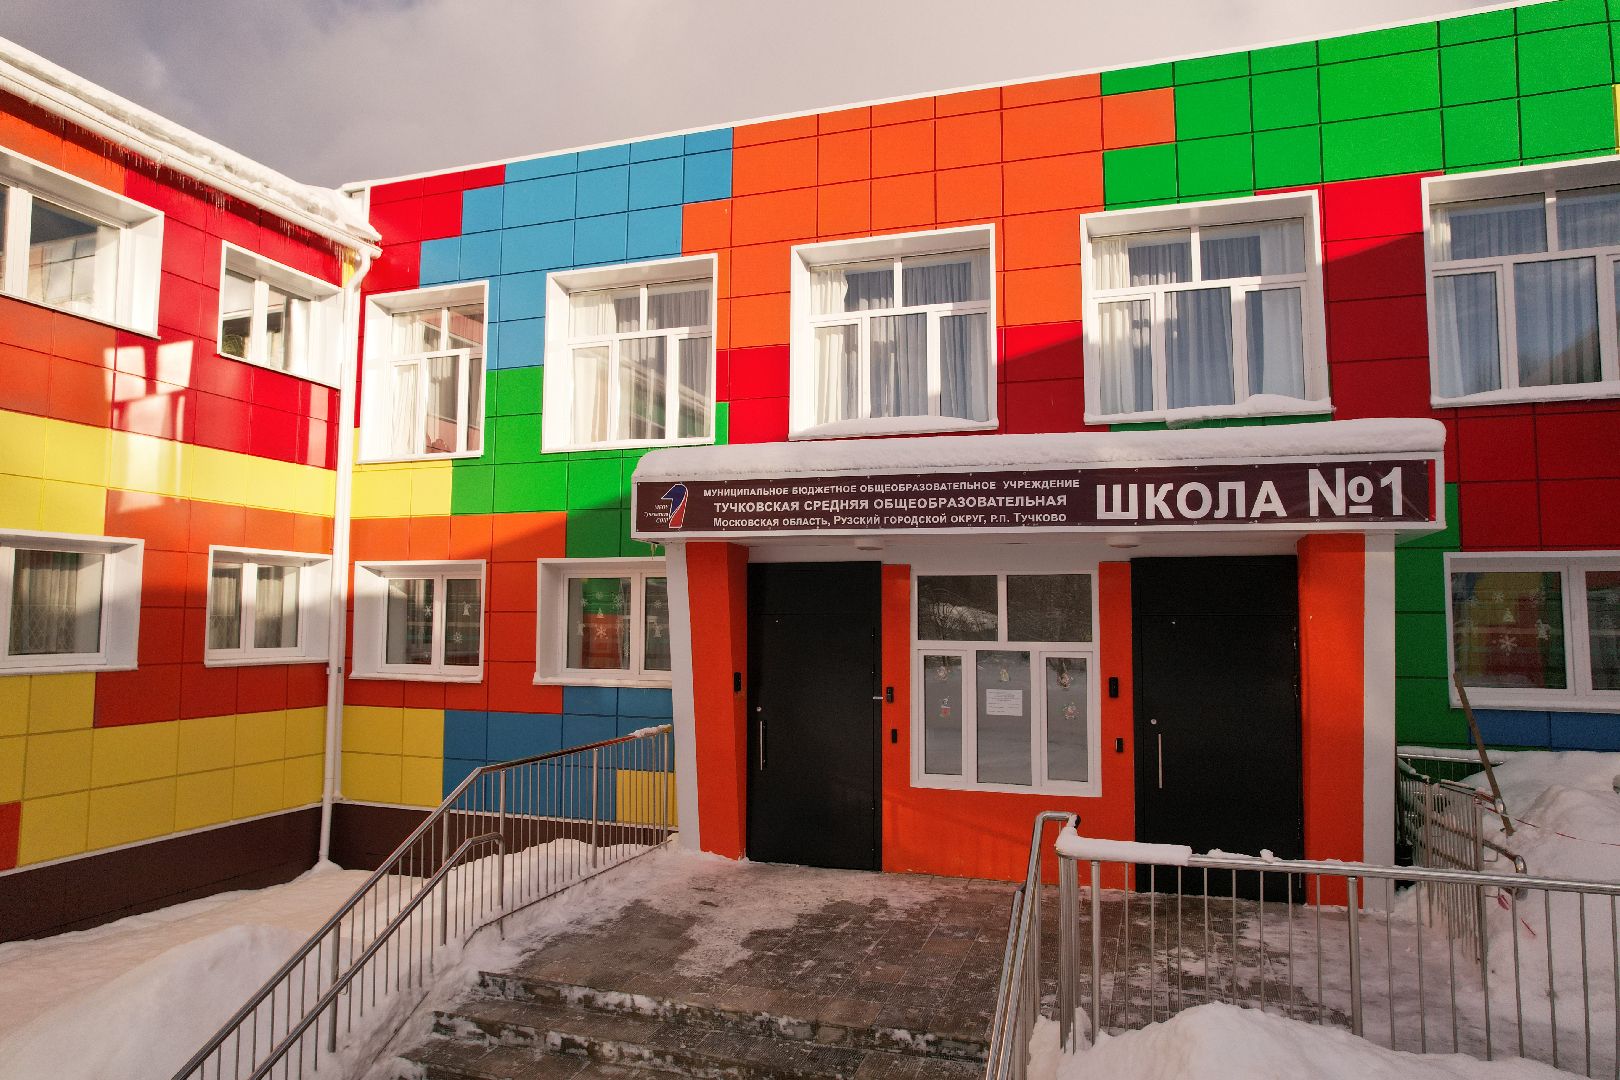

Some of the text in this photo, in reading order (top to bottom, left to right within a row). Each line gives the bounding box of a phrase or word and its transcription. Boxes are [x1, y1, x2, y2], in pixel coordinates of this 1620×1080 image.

[703, 479, 1080, 497] МУНИЦИПАЛЬНОЕ БЮДЖЕТНОЕ ОБЩЕОБРАЗОВАТЕЛЬНОЕ УЧРЕЖДЕНИЕ
[1096, 466, 1403, 520] ШКОЛА №1
[713, 494, 1067, 513] ТУЧКОВСКАЯ СРЕДНЯЯ ОБЩЕОБРАЗОВАТЕЛЬНАЯ
